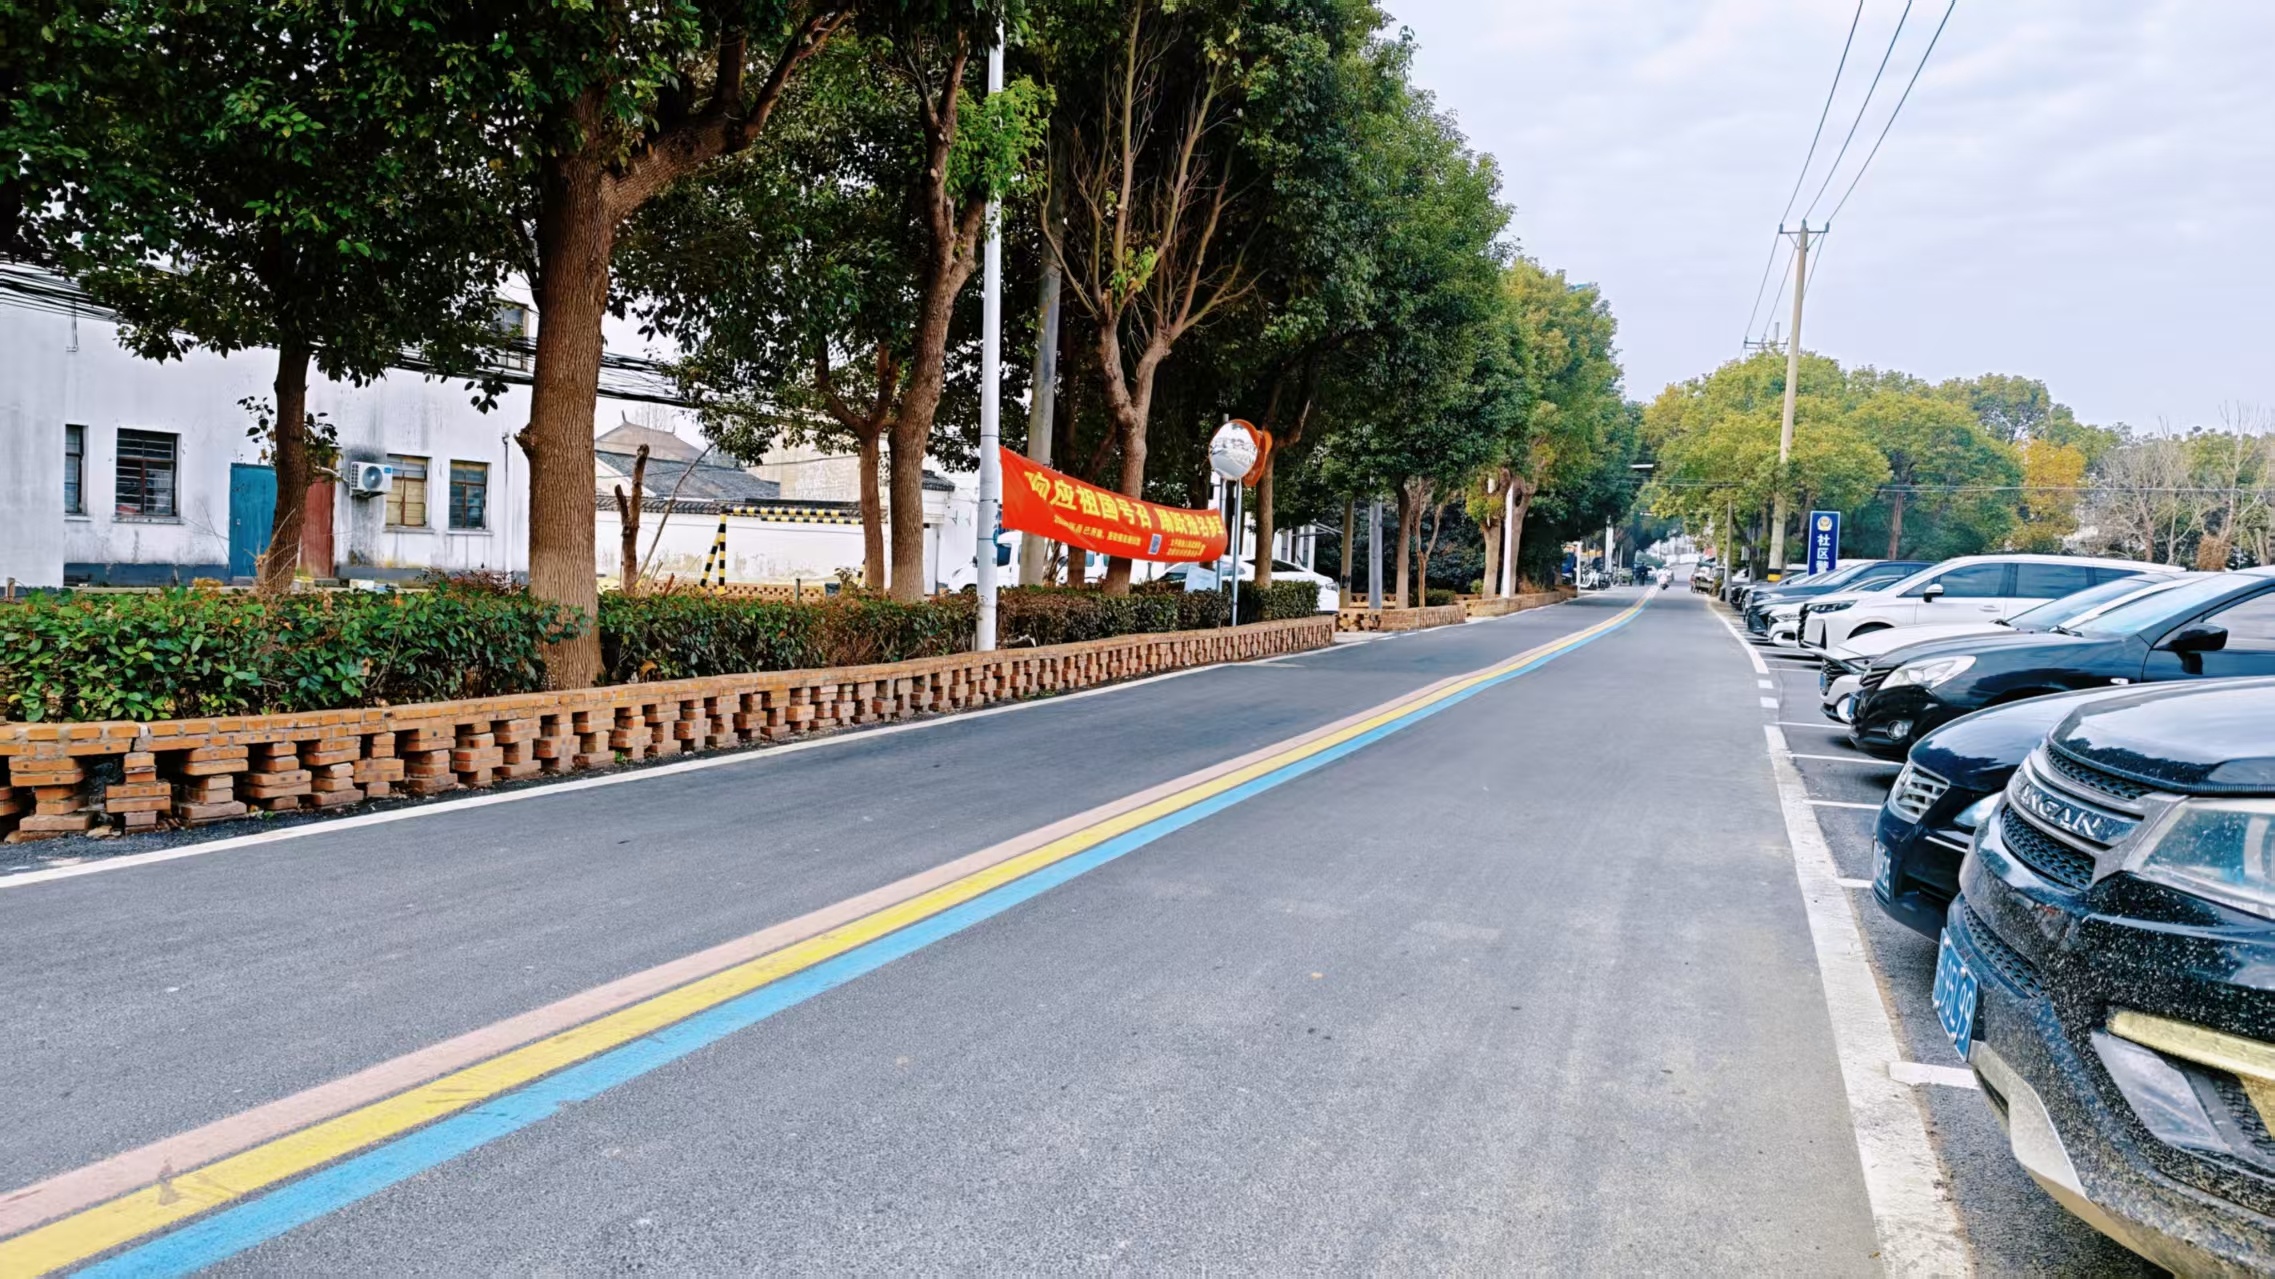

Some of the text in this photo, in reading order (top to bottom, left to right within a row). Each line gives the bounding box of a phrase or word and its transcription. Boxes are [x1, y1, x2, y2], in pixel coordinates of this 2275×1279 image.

[1024, 472, 1152, 529] 响应祖国号召
